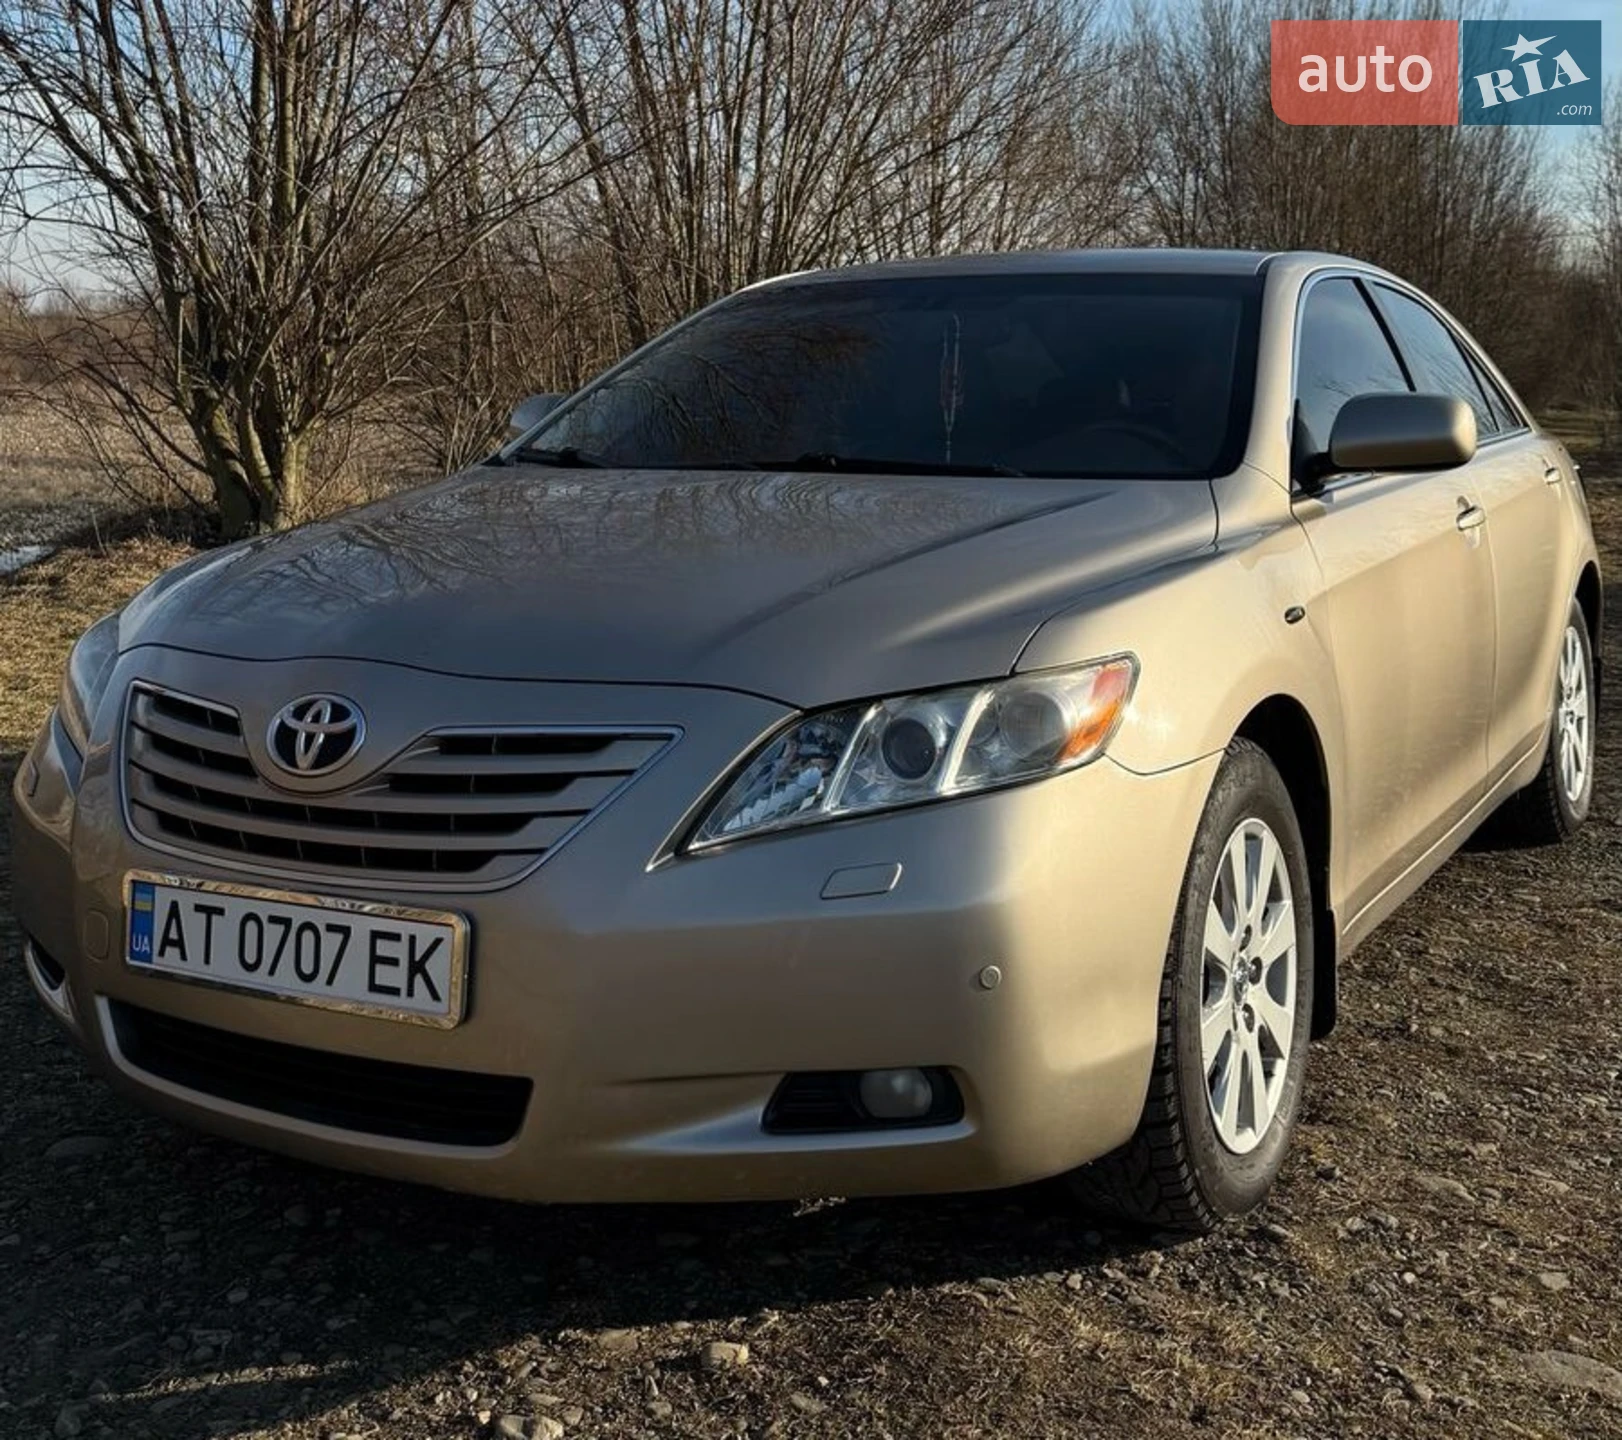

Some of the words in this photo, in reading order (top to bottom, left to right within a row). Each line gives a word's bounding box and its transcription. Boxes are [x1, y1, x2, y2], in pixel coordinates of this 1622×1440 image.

[132, 934, 151, 954] UA
[157, 899, 225, 966] AT
[238, 911, 352, 987] 0707
[367, 928, 445, 1003] EK
